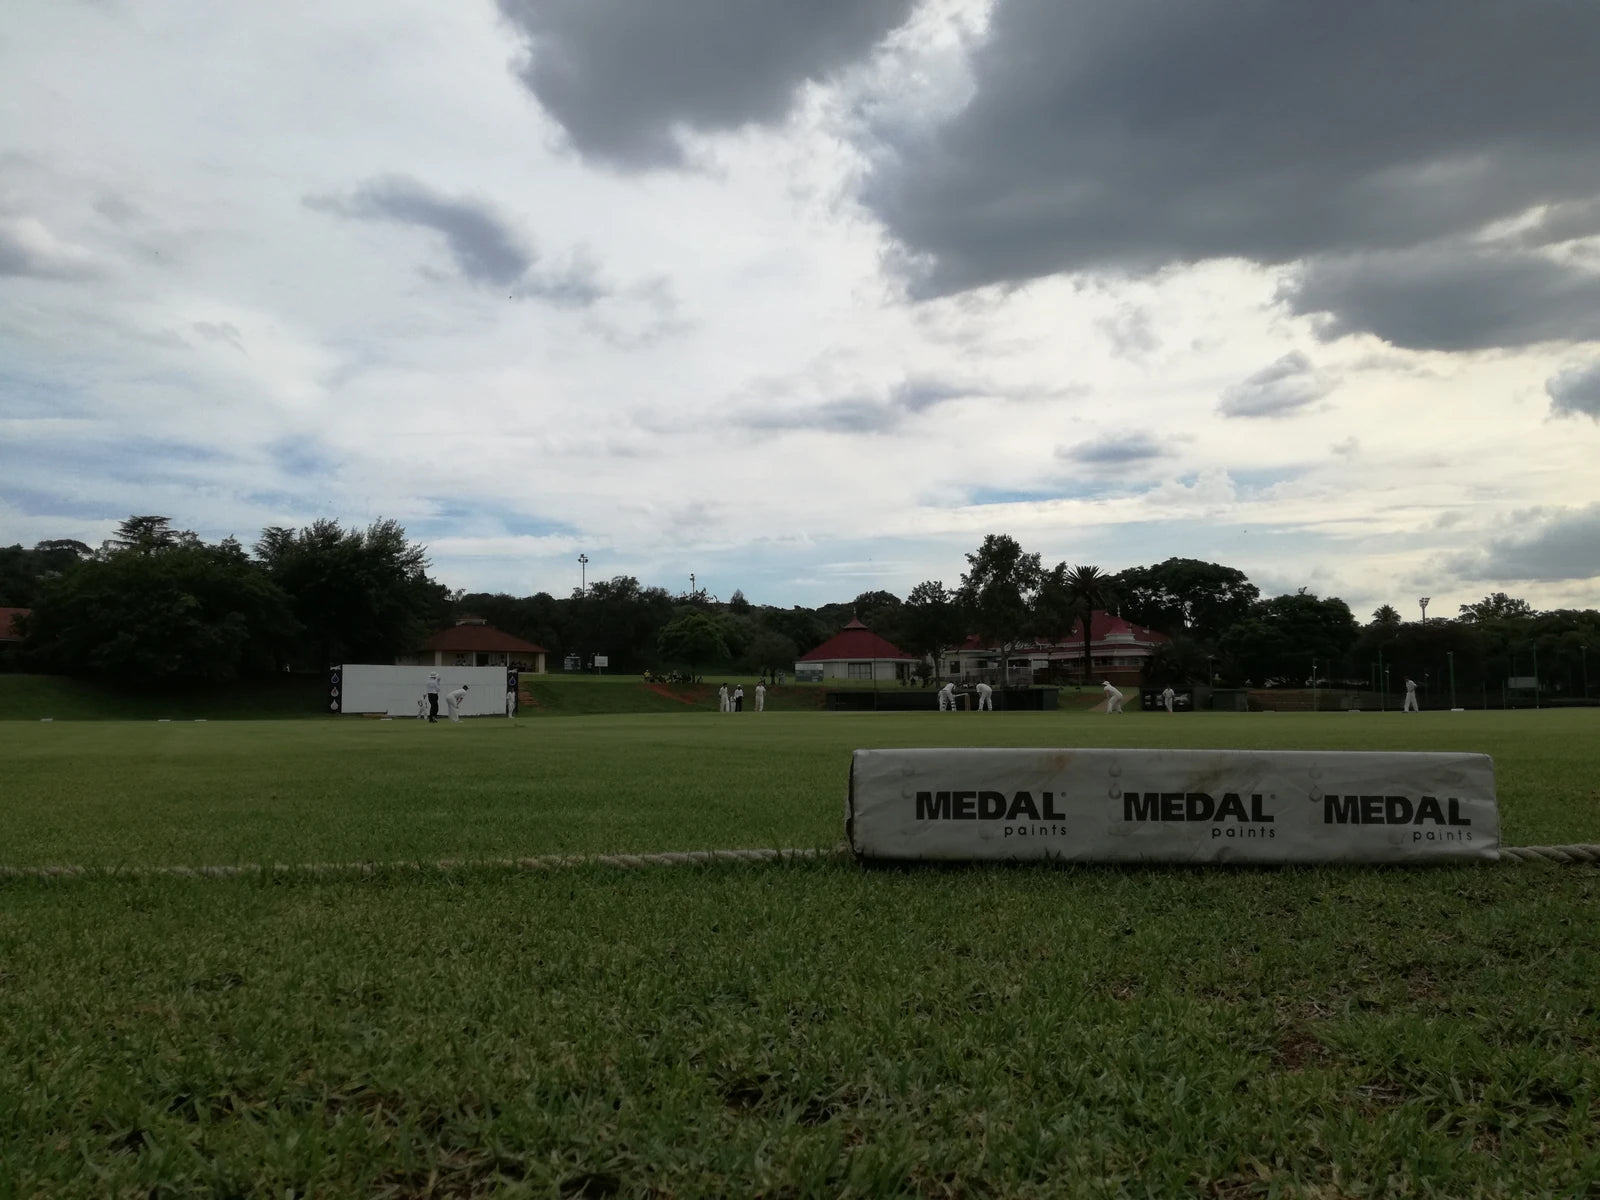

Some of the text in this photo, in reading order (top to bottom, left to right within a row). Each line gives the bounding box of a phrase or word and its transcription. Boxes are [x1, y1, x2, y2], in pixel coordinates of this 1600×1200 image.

[916, 791, 1066, 820] MEDAL
[1123, 792, 1275, 822] MEDAL
[1323, 794, 1471, 826] MEDAL
[1004, 824, 1067, 838] paints
[1211, 826, 1276, 839] paints
[1412, 829, 1473, 842] paints
